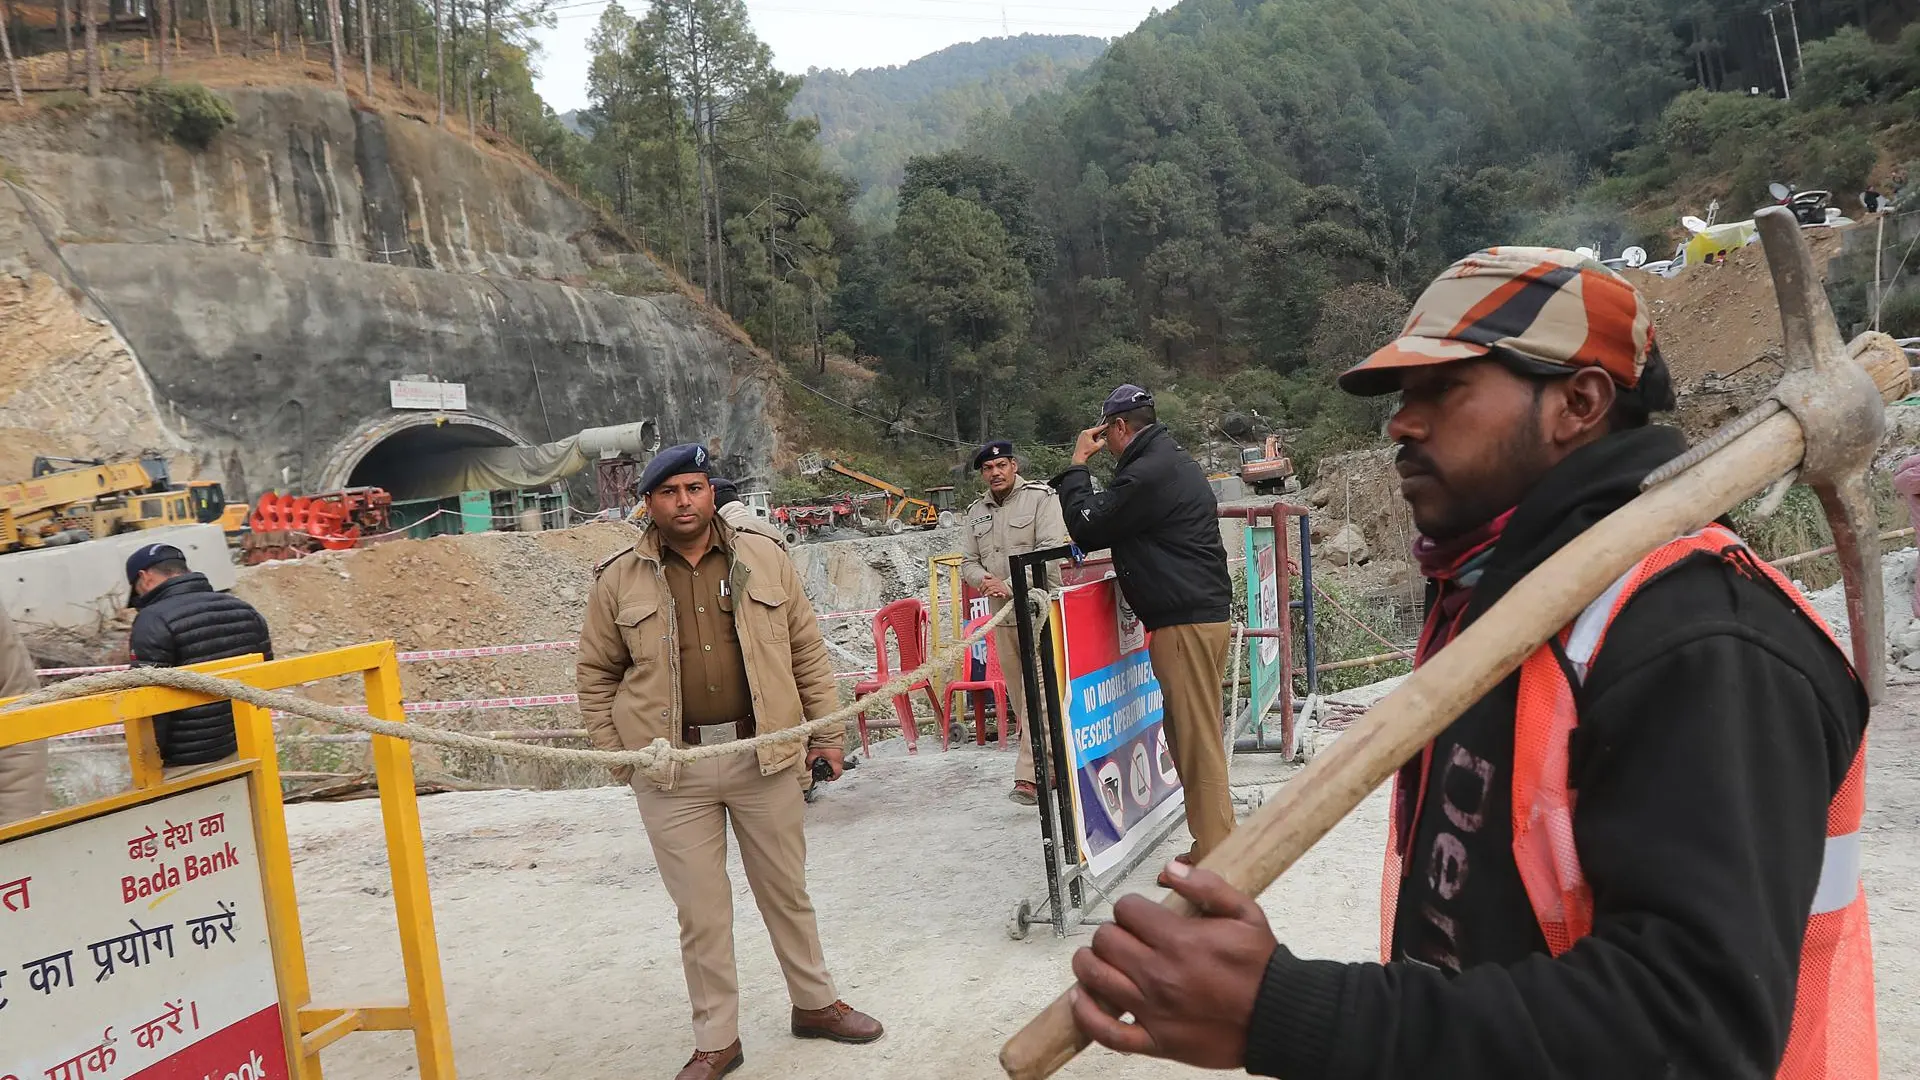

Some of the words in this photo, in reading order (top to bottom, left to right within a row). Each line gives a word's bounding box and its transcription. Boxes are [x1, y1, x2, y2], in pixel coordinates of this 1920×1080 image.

[1083, 686, 1096, 713] NO
[1097, 672, 1126, 706] MOBILE
[1075, 716, 1112, 752] RESCUE
[128, 825, 158, 862] बड़े
[163, 819, 193, 850] देश
[198, 812, 225, 836] का
[121, 863, 180, 904] Bada
[184, 841, 239, 881] Bank
[22, 950, 75, 995] का
[87, 918, 174, 984] प्रयोग
[186, 901, 236, 950] करें
